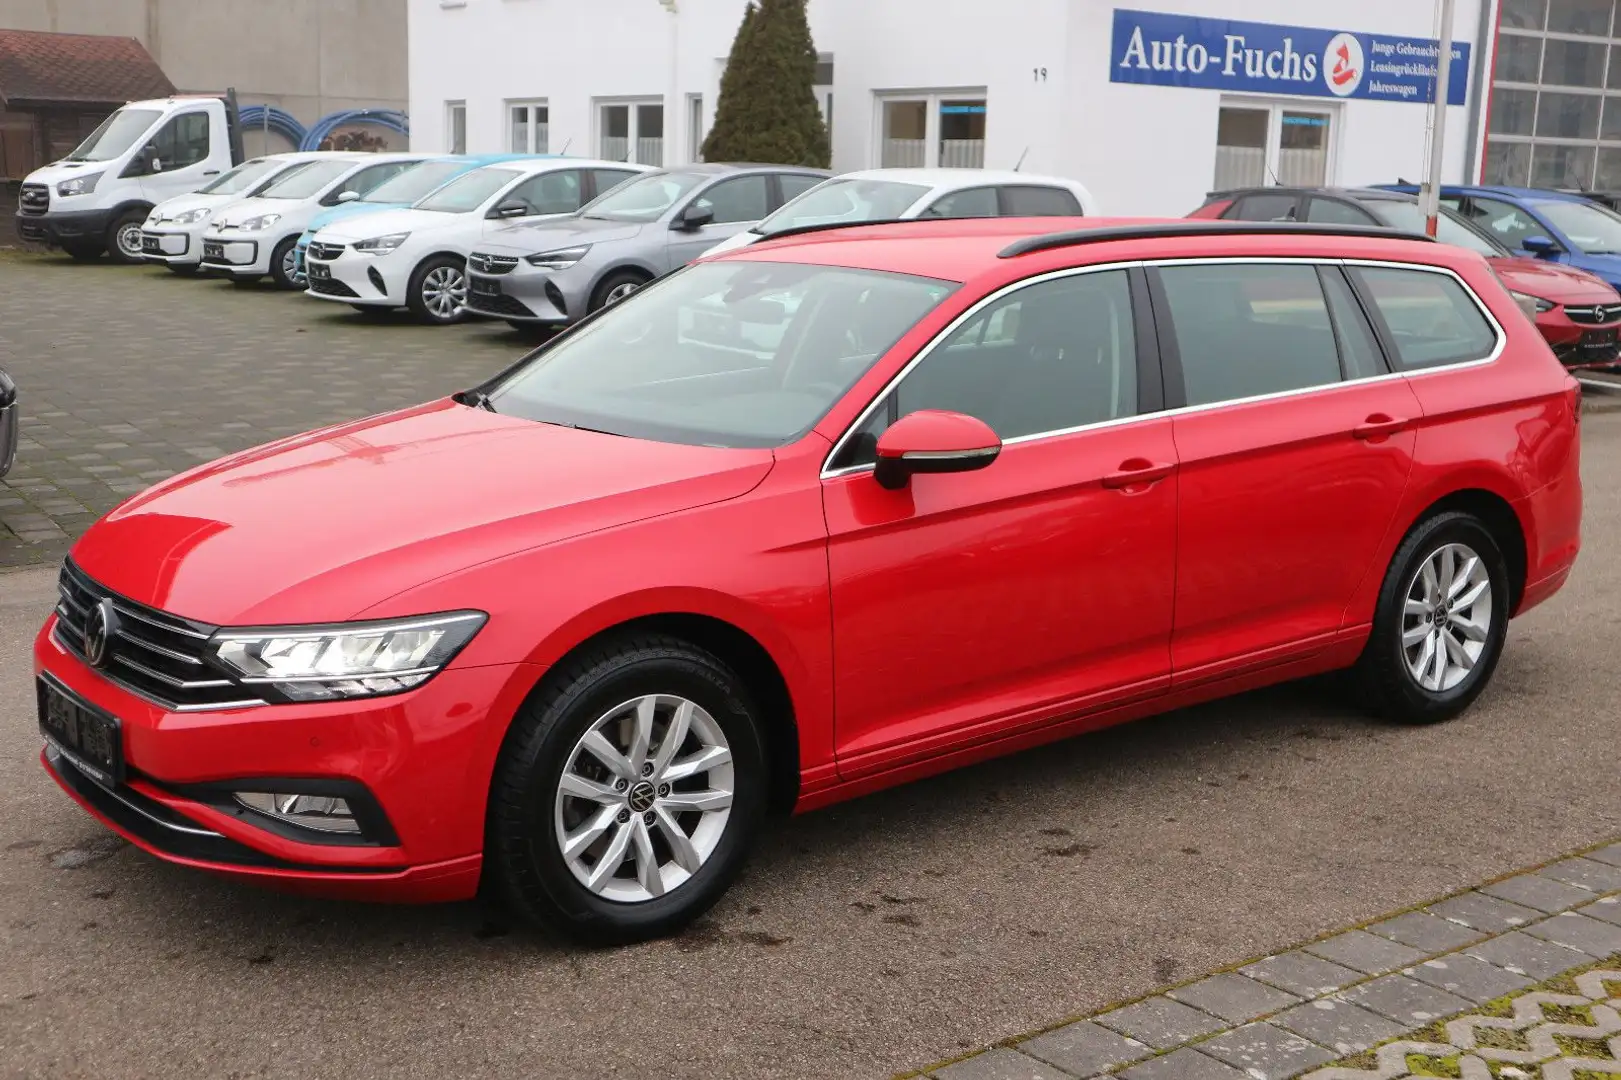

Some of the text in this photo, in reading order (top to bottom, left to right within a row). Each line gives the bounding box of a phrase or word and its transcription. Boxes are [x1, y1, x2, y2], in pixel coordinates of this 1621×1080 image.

[1119, 25, 1317, 82] Auto-Fuchs
[1372, 39, 1395, 56] Junge
[1033, 67, 1047, 82] 19
[1369, 80, 1418, 98] Jahreswagen
